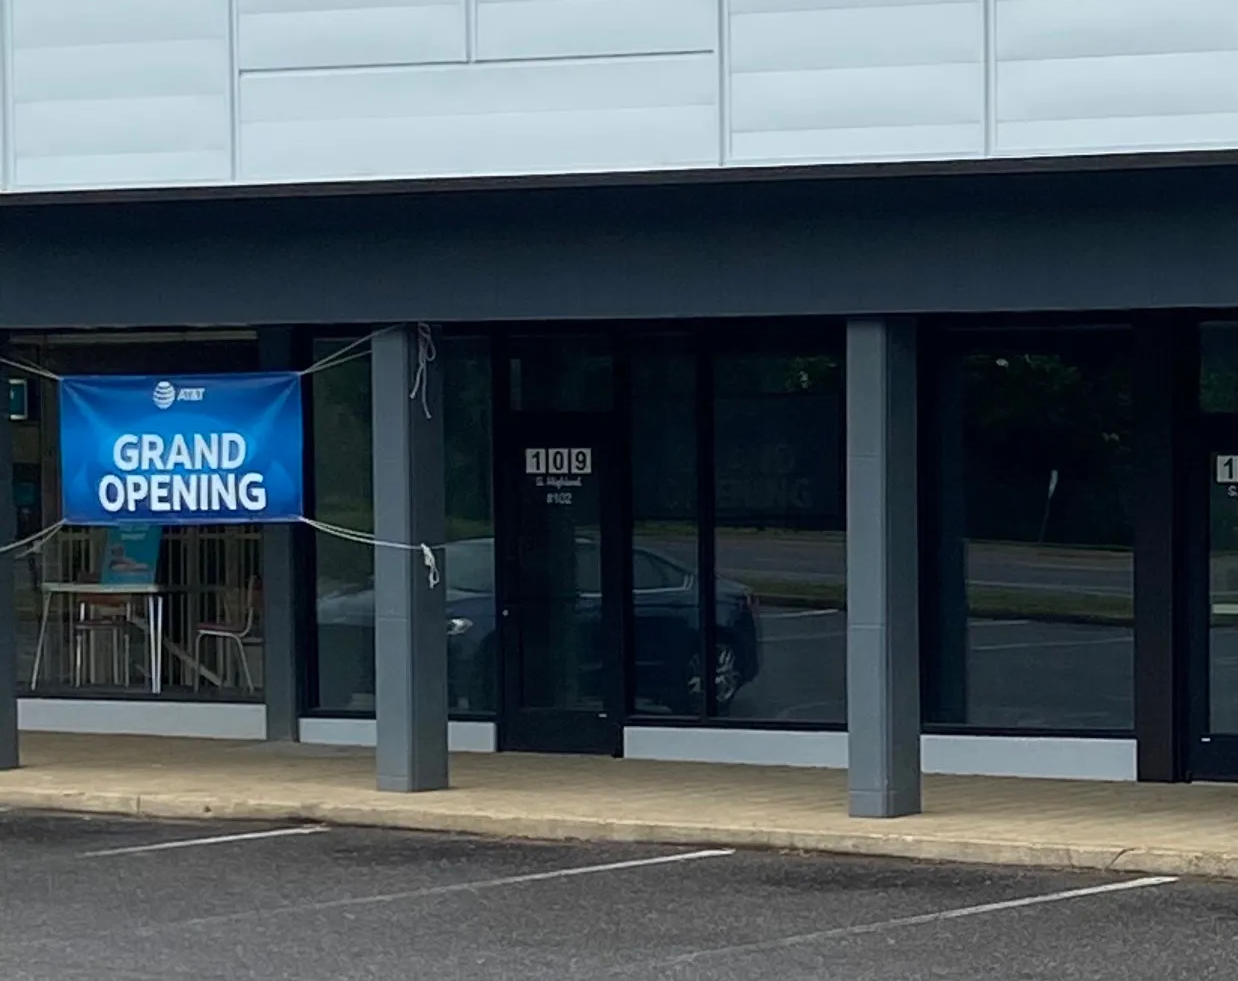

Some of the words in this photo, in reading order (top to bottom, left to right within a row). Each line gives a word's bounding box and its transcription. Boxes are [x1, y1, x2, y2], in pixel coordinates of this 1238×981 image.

[177, 387, 206, 401] AT&T
[113, 432, 247, 471] GRAND
[529, 450, 588, 472] 109
[98, 473, 267, 512] OPENING
